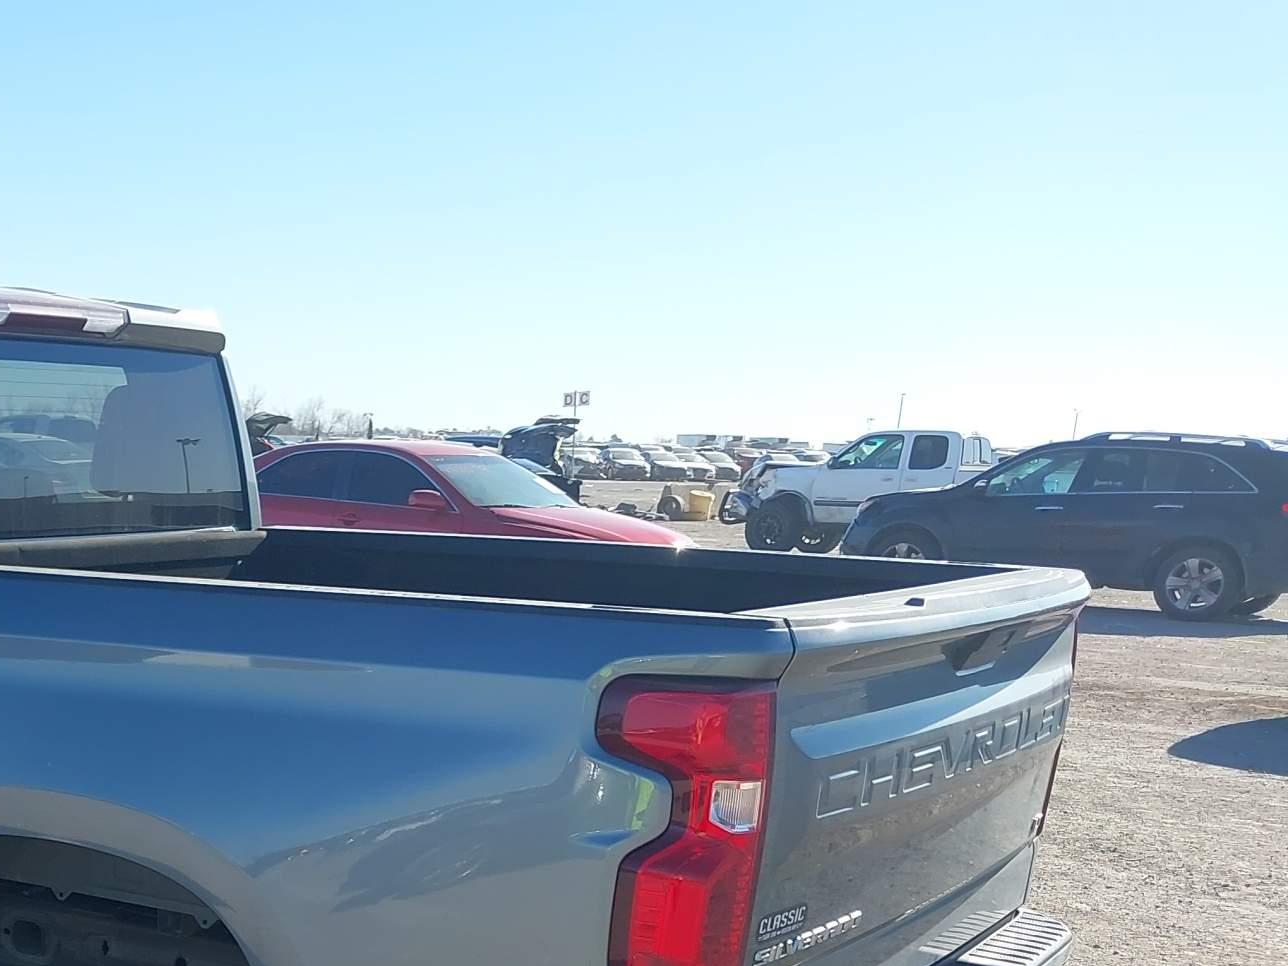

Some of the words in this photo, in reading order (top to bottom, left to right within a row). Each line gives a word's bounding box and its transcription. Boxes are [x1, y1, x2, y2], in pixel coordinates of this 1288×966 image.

[564, 394, 573, 406] D
[580, 393, 590, 405] C
[814, 686, 1071, 819] CHEVROLET
[758, 905, 807, 935] CLASSIC
